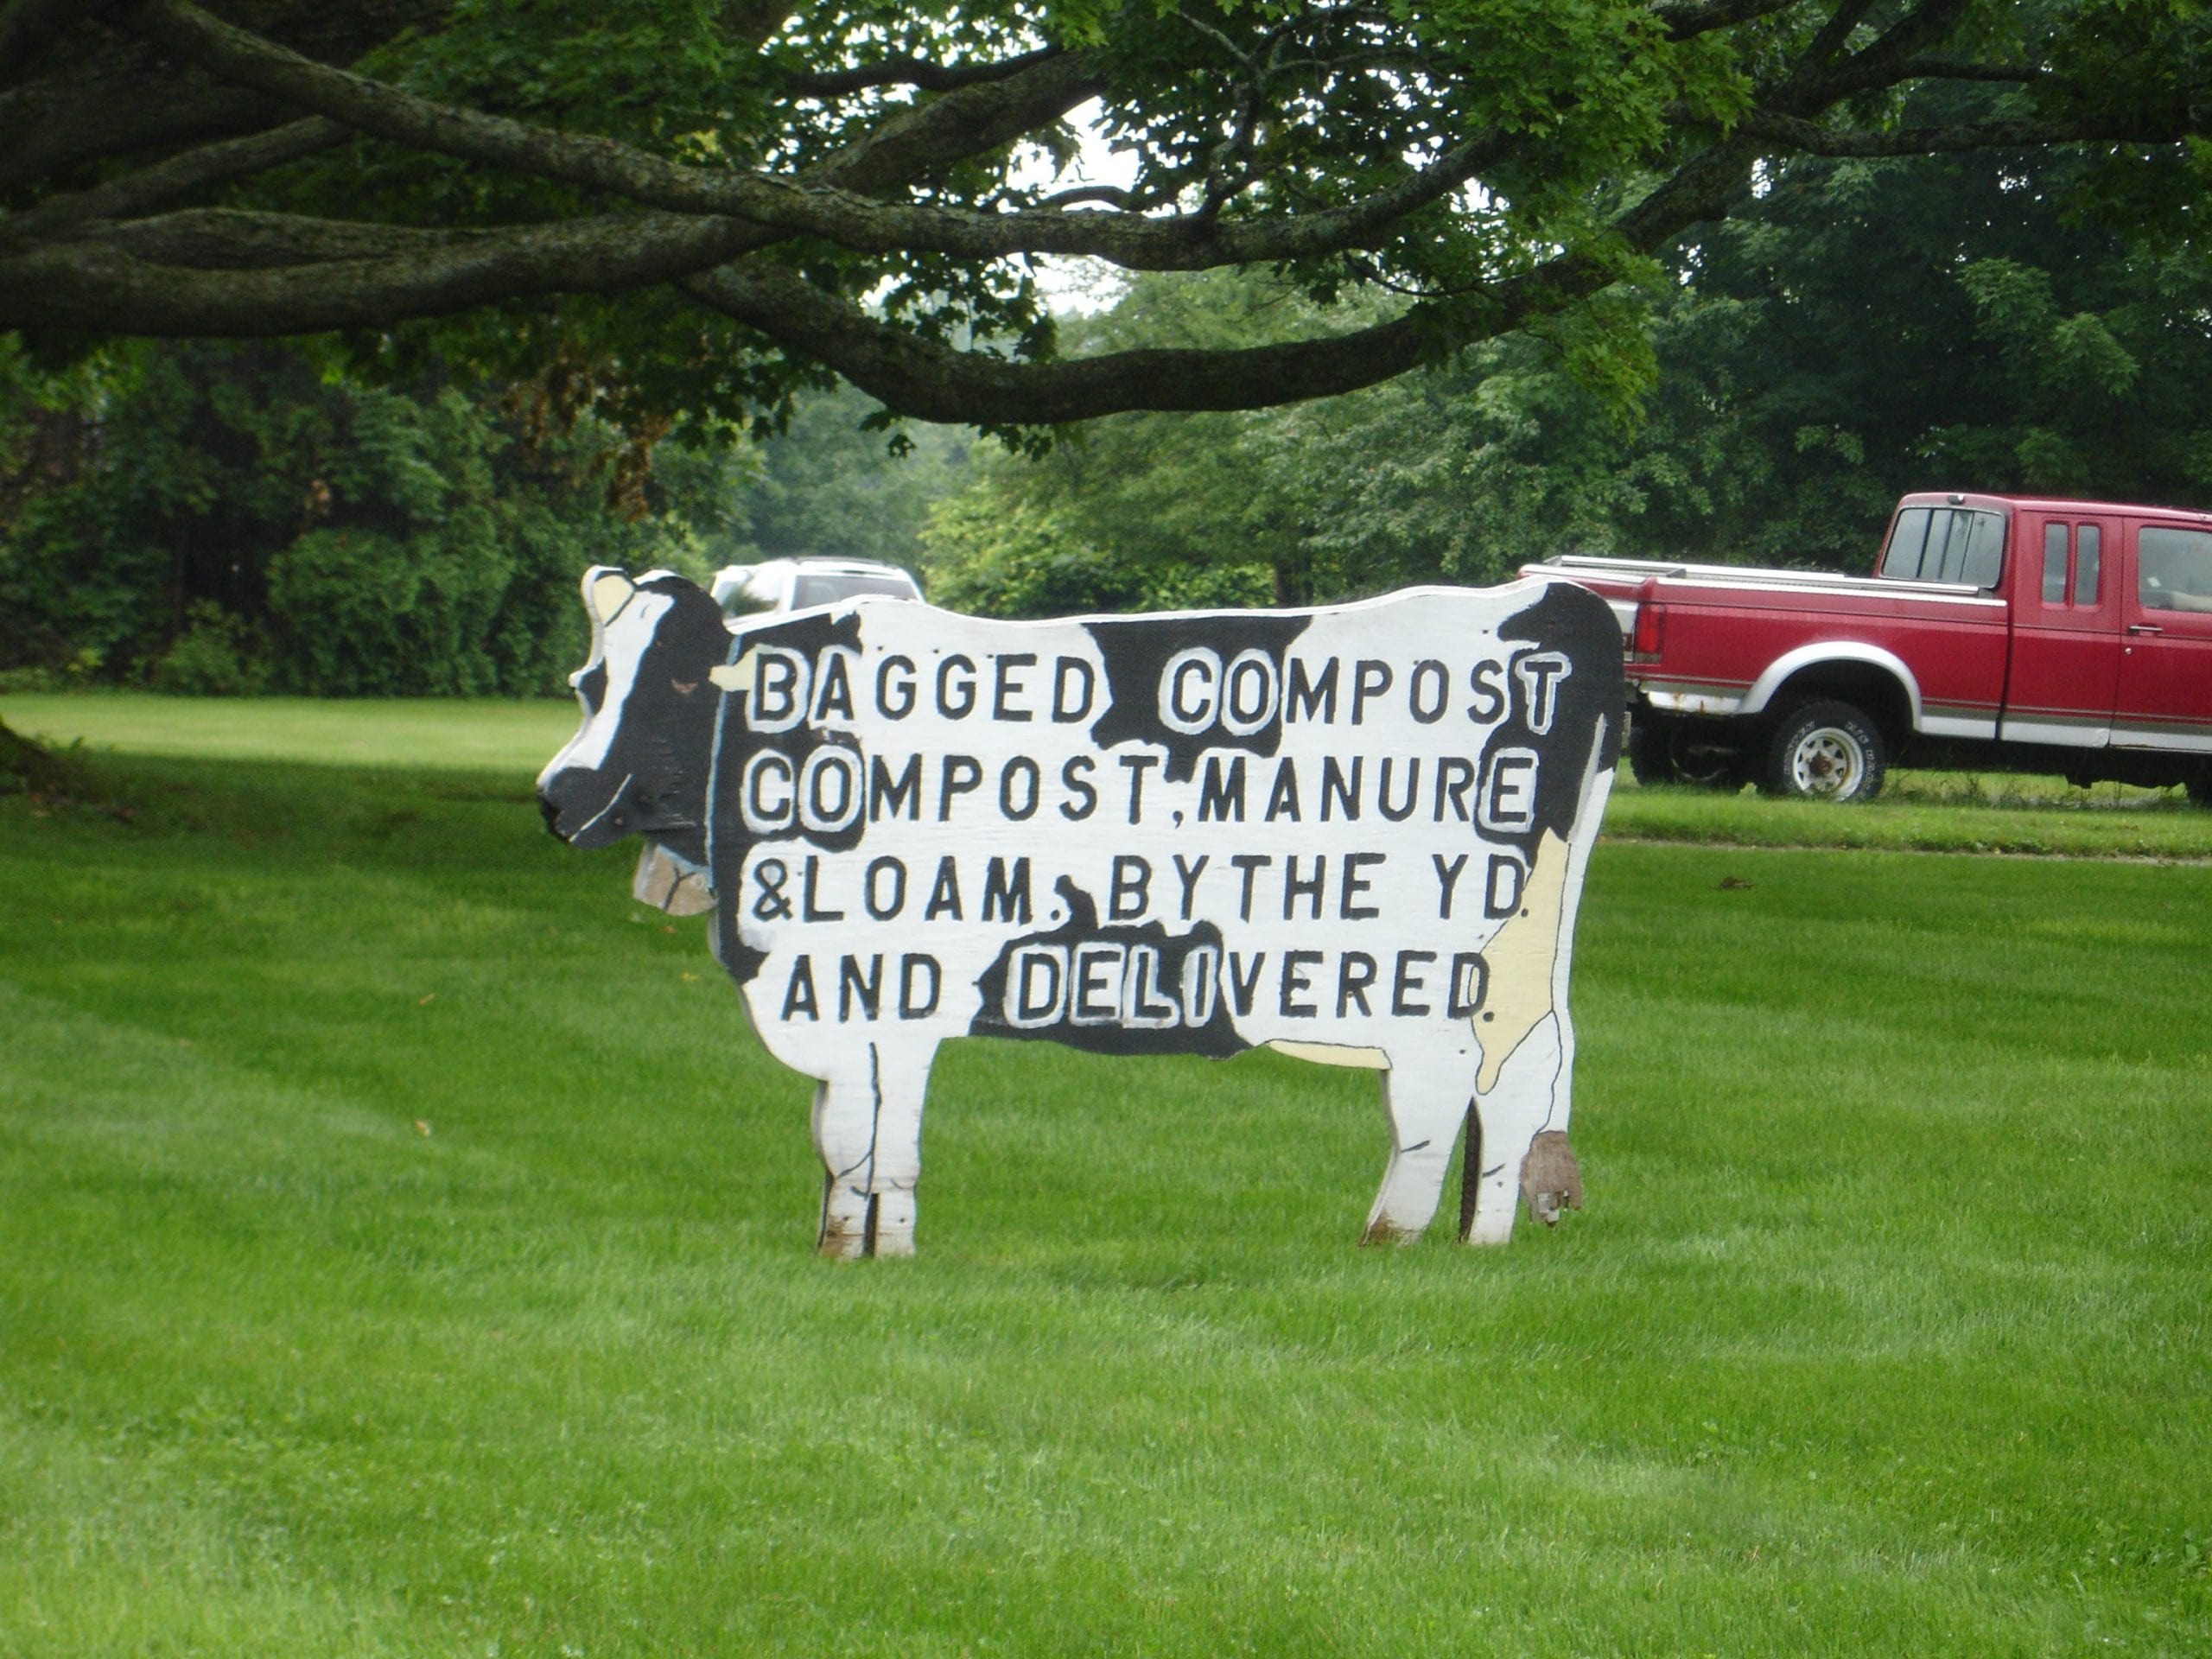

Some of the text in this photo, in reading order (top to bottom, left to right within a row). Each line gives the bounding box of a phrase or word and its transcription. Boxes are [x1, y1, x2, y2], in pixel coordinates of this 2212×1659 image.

[753, 653, 1563, 726] BAGGED COMPOST
[1198, 755, 1535, 823] MANURE
[1109, 855, 1211, 922] BY
[1231, 852, 1386, 923] THE
[1432, 853, 1529, 921] YD.
[780, 950, 1495, 1022] AND DELIVERED.
